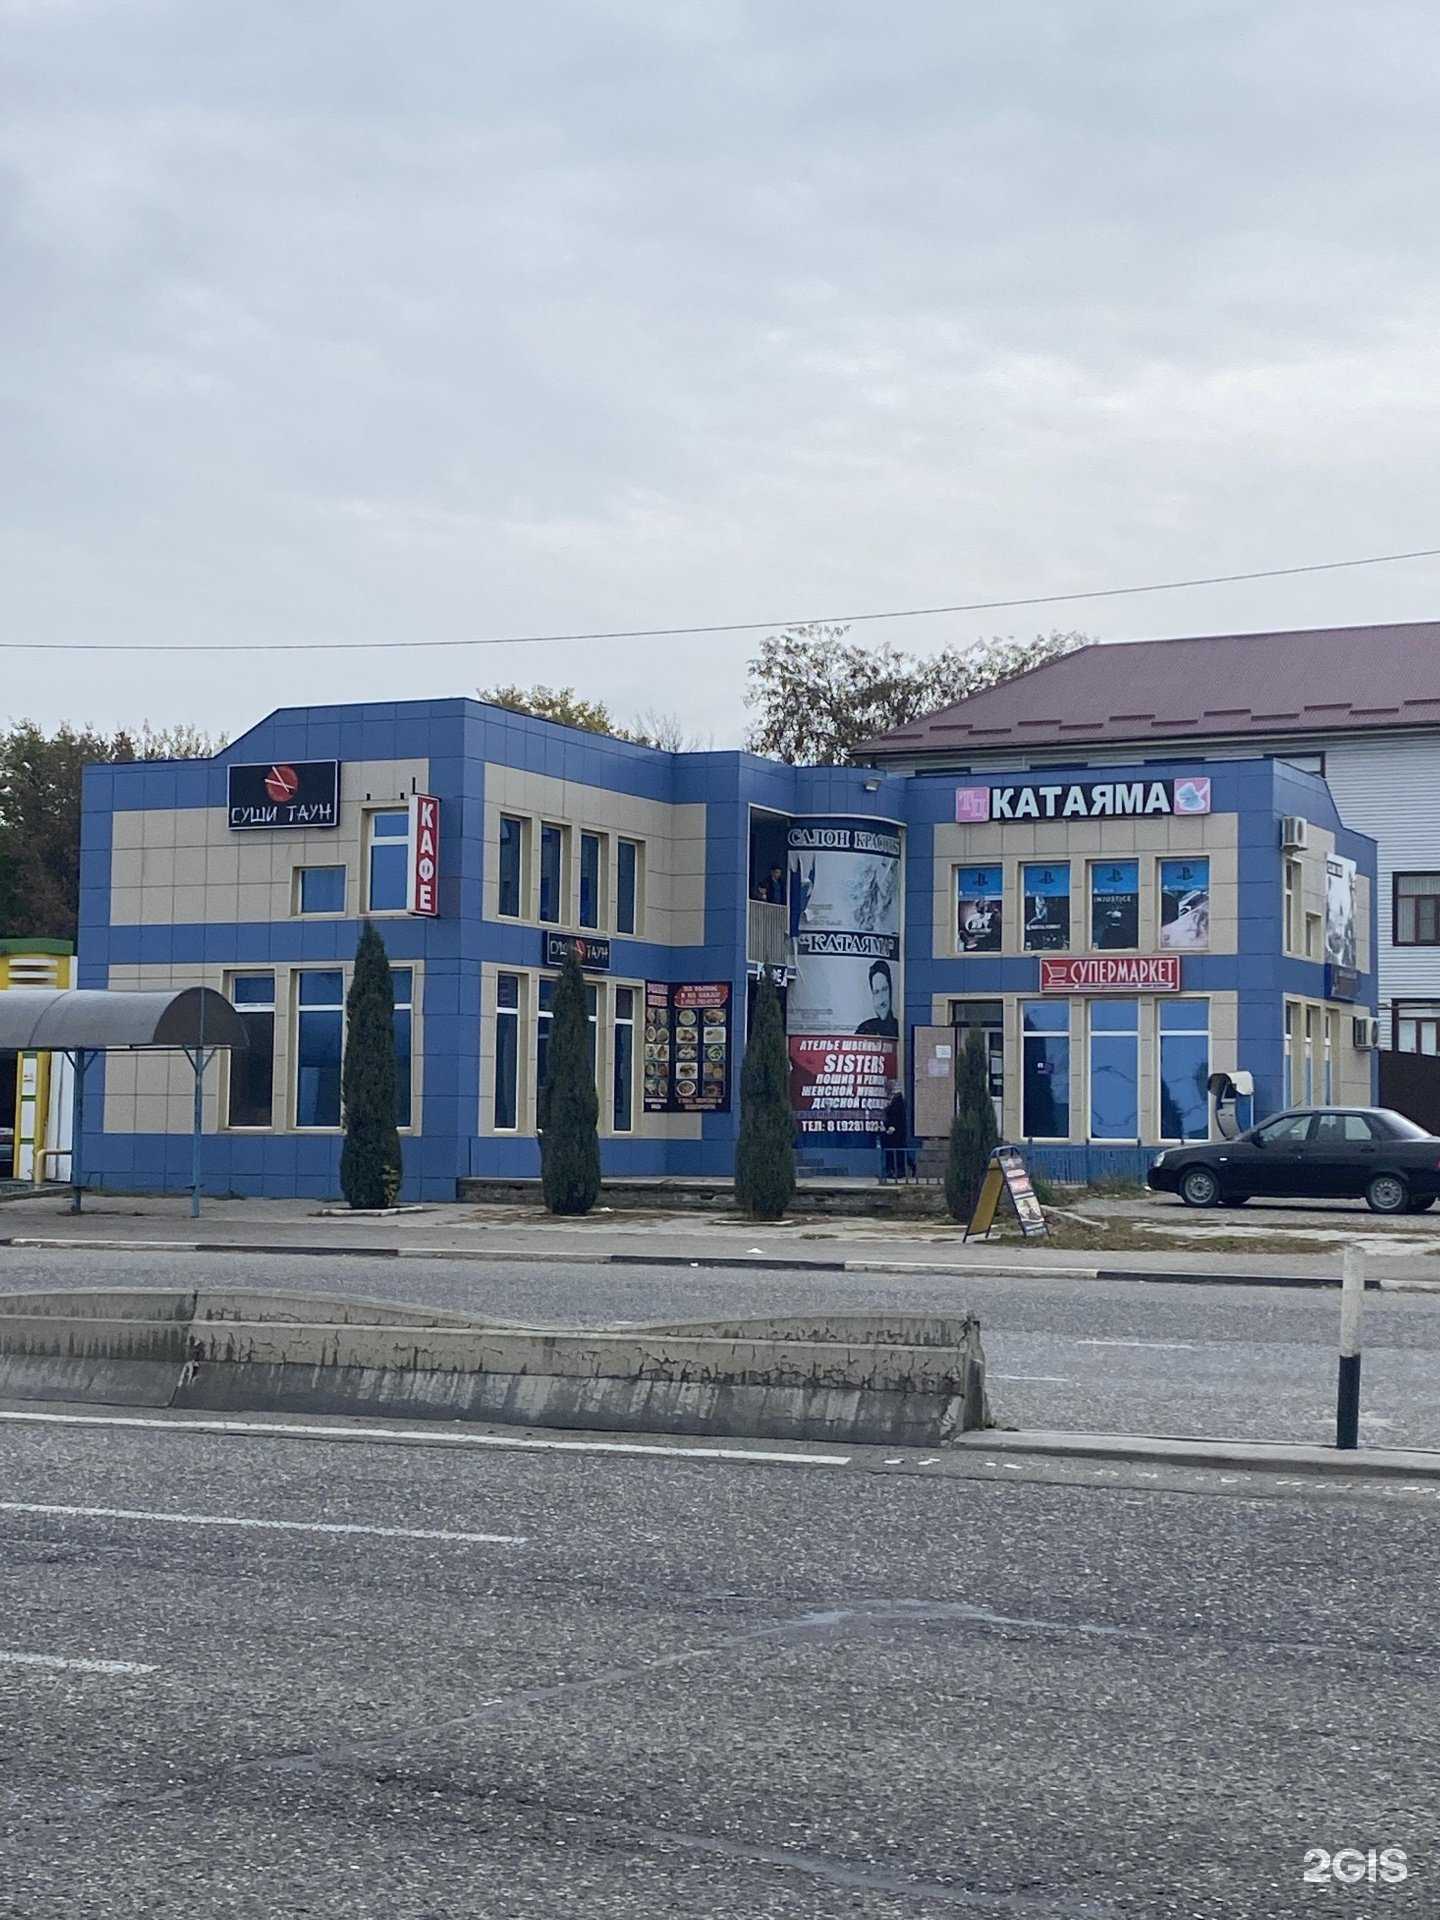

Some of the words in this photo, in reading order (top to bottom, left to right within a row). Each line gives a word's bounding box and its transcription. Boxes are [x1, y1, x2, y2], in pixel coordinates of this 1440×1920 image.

[992, 782, 1171, 819] КАТАЯМА
[231, 806, 277, 824] СУШИ
[287, 803, 332, 822] ТАУН
[788, 828, 850, 847] САЛОН
[419, 801, 435, 911] КАФЕ
[1070, 959, 1175, 983] СУПЕРМАРКЕТ
[800, 1040, 840, 1051] АТЕЛЬЕ
[823, 1054, 885, 1074] SISTERS
[816, 1074, 855, 1084] ПОШИВ
[827, 1121, 835, 1131] 8
